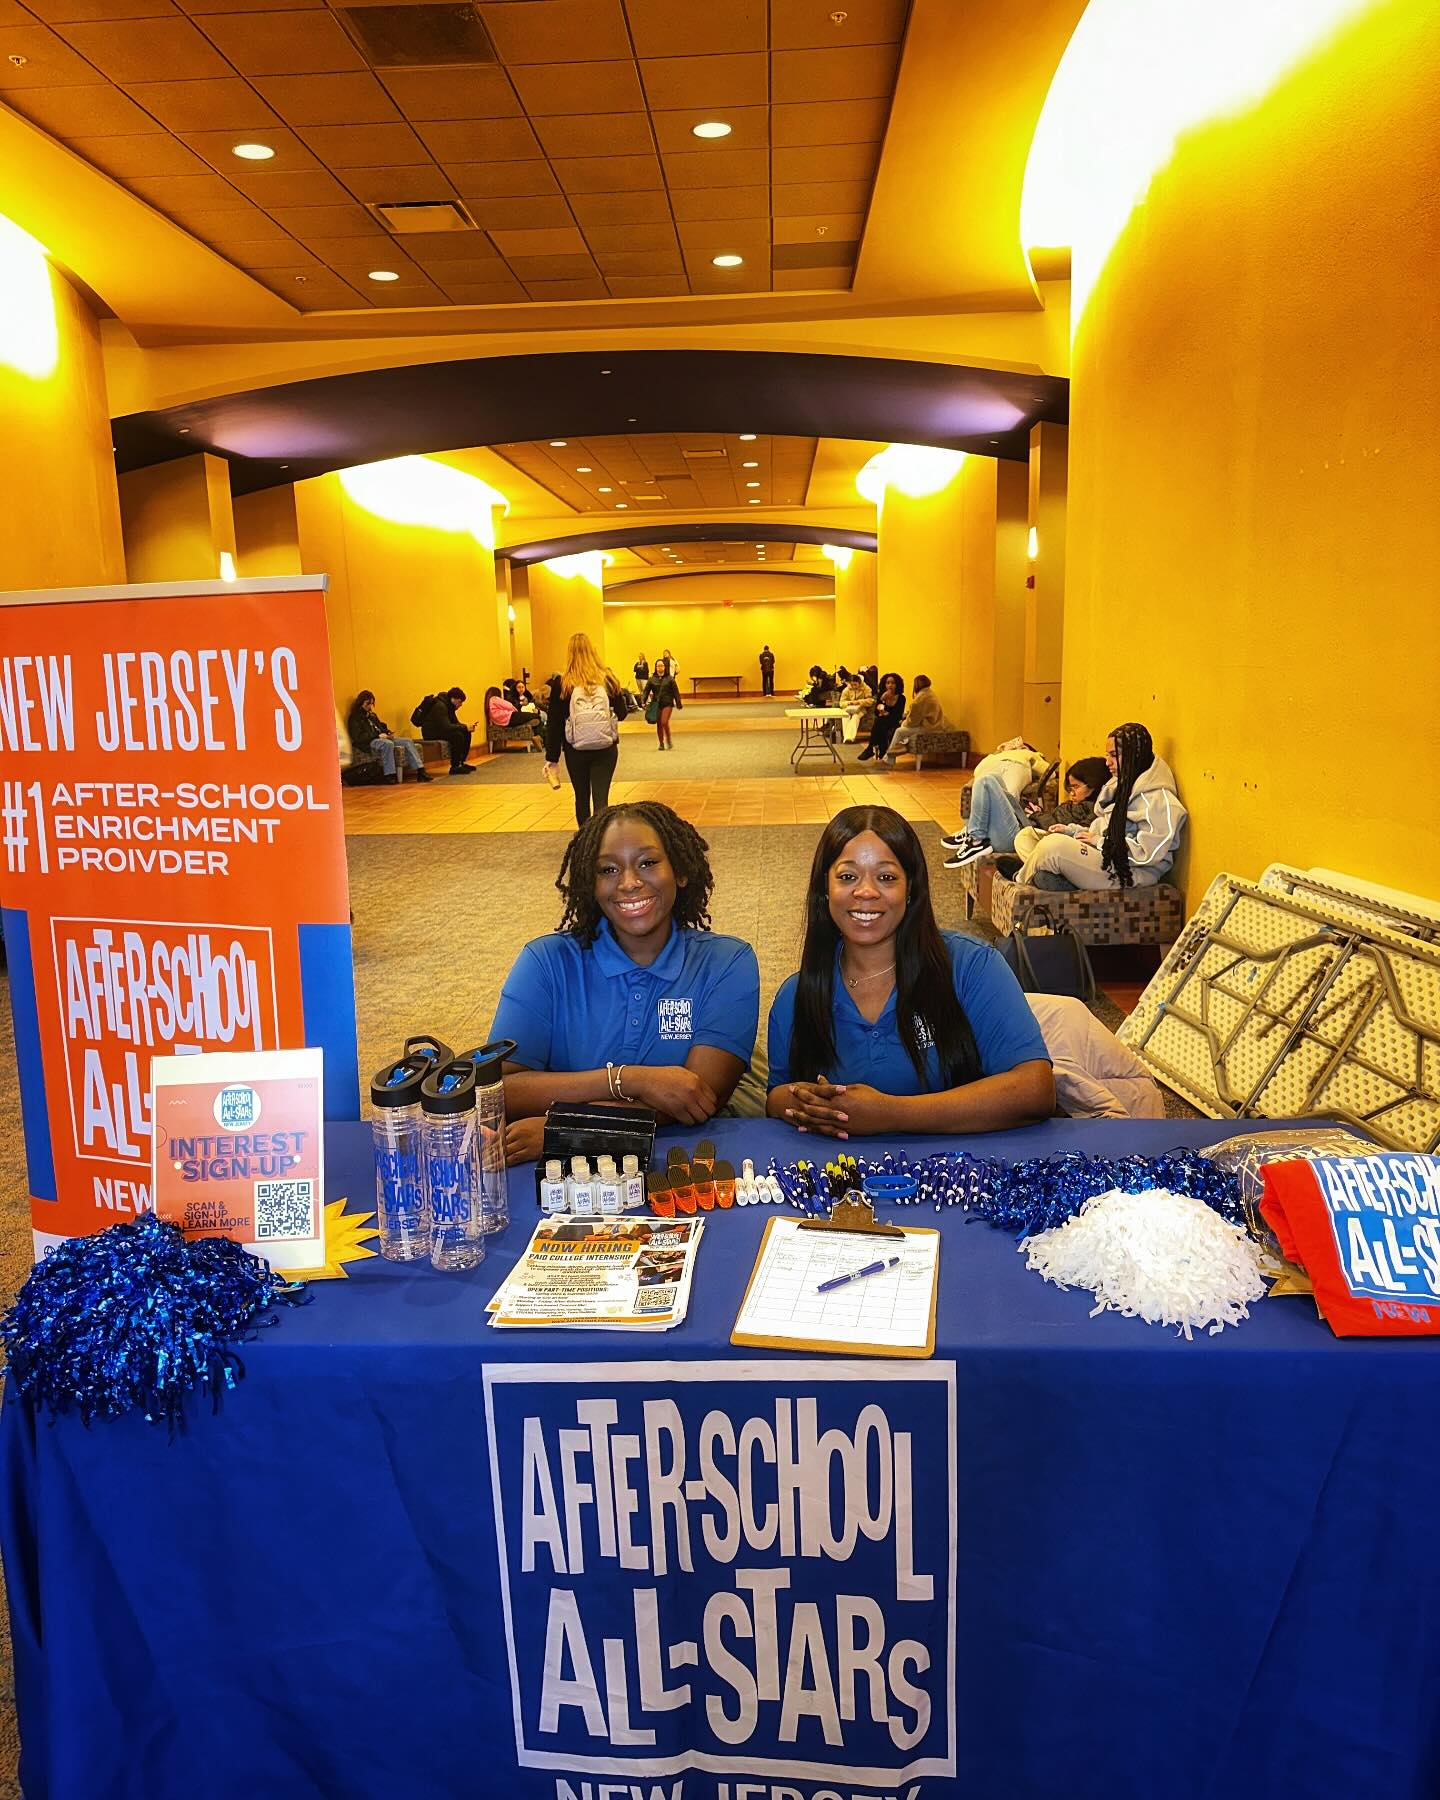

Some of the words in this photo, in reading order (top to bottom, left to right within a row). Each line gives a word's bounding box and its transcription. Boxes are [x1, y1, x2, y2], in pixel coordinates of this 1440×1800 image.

[0, 655, 75, 751] NEW
[96, 647, 302, 751] JERSEY'S
[51, 783, 330, 810] AFTER-SCHOOL
[2, 782, 49, 873] #1
[55, 815, 281, 844] ENRICHMENT
[57, 847, 230, 876] PROIVDER
[66, 929, 262, 1051] AFTER-SCHOOL
[169, 1131, 308, 1160] INTEREST
[182, 1155, 298, 1182] SIGN-UP
[93, 1177, 151, 1212] NEW
[187, 1202, 216, 1211] SCAN
[219, 1201, 225, 1210] &
[183, 1219, 217, 1229] LEARN
[220, 1217, 250, 1228] MORE
[184, 1210, 228, 1220] SIGN-UP
[540, 1243, 577, 1253] NOW
[581, 1243, 632, 1253] HIRING
[1372, 1301, 1430, 1323] NEW
[522, 1397, 934, 1600] AFTER-SCHOOL
[539, 1568, 931, 1750] ALL-STARS
